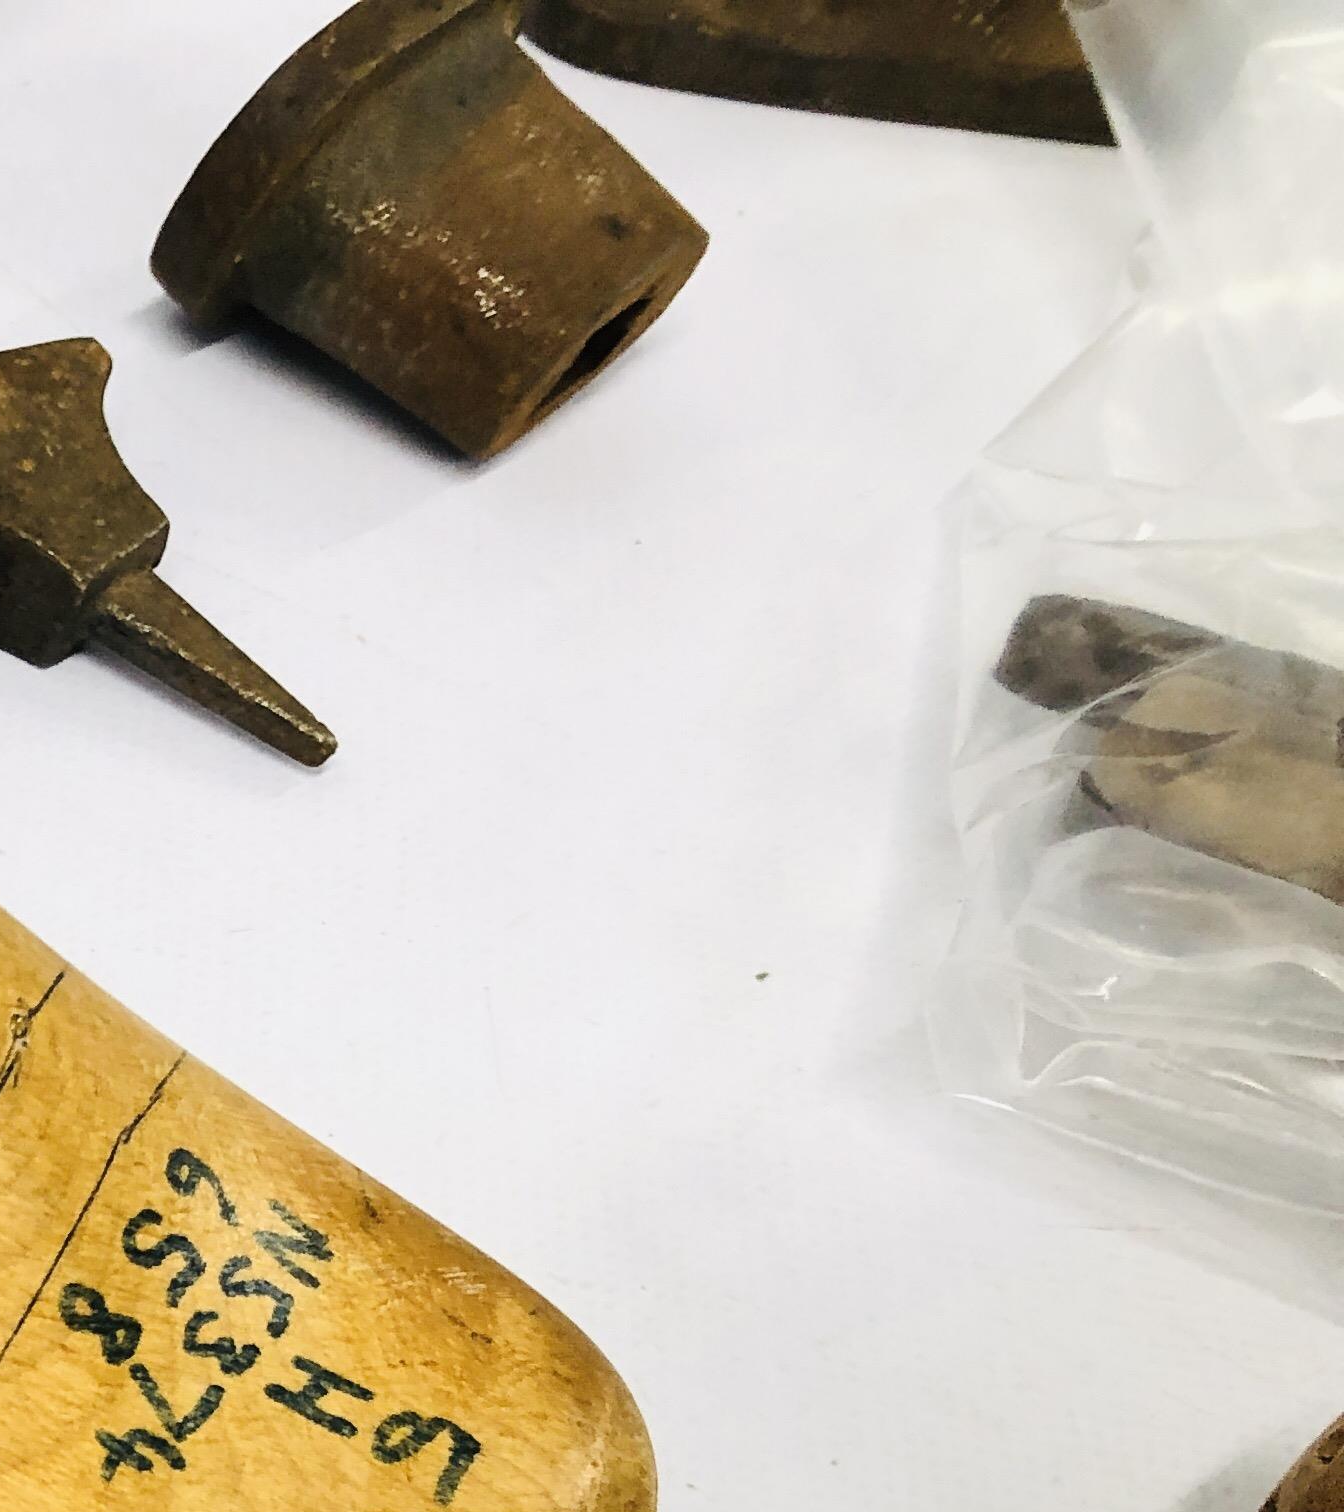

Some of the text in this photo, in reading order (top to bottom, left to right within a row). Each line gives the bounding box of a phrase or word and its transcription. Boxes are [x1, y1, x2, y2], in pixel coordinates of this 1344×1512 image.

[60, 1146, 240, 1366] 658
[93, 1196, 335, 1482] N5374
[262, 1351, 375, 1439] H
[370, 1408, 484, 1507] 6
